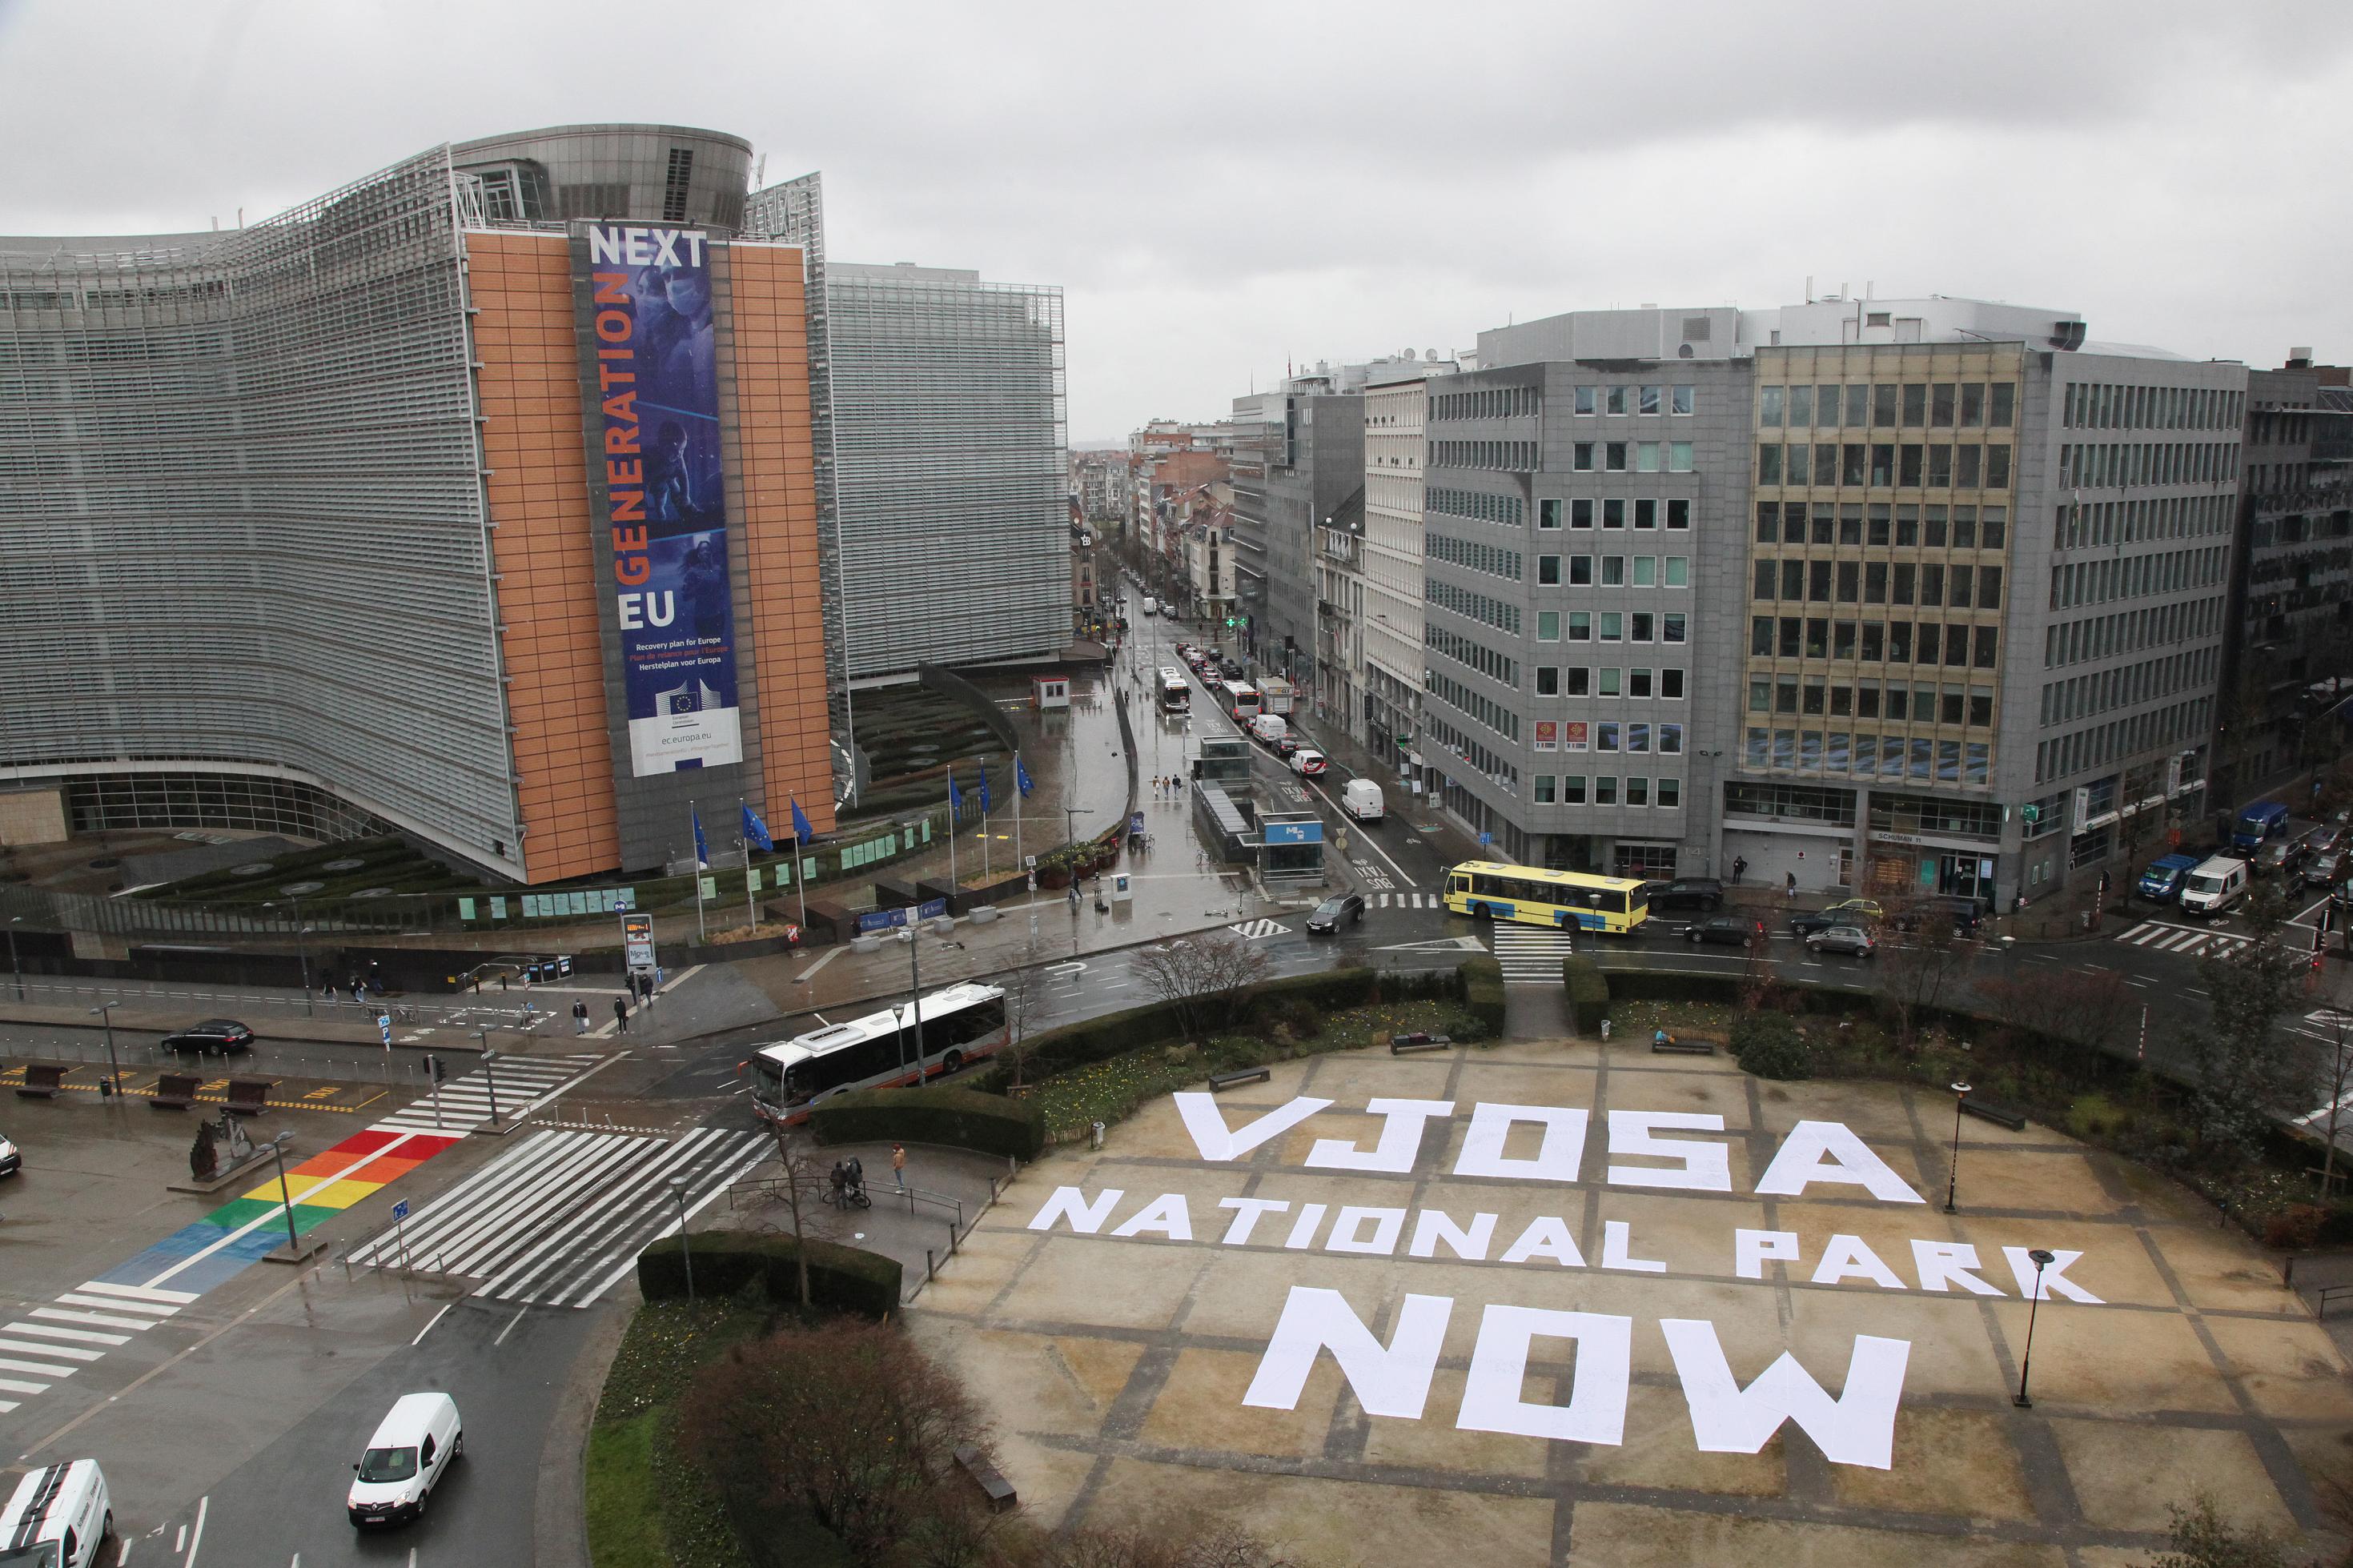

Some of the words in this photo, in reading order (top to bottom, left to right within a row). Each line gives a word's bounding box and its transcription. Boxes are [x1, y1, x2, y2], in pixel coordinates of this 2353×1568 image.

[589, 226, 707, 267] NEXT
[592, 272, 650, 585] GENERATION
[617, 591, 675, 630] EU
[636, 643, 668, 651] Recovery
[669, 640, 685, 648] plan
[698, 637, 721, 645] Europe
[639, 660, 679, 671] Herstelplan
[698, 656, 721, 665] Europa
[661, 732, 712, 745] ec.europa.eu
[1878, 833, 1912, 842] SCHUMAN
[1685, 847, 1703, 855] 14
[1354, 866, 1388, 877] TAXI
[1367, 878, 1395, 888] BUS
[383, 1027, 388, 1037] P
[303, 1087, 342, 1099] TAXI
[1174, 1093, 1925, 1203] VJOSA
[1029, 1187, 1666, 1273] NATIONAL
[1736, 1229, 2106, 1304] PARK
[1243, 1287, 1909, 1469] NOW
